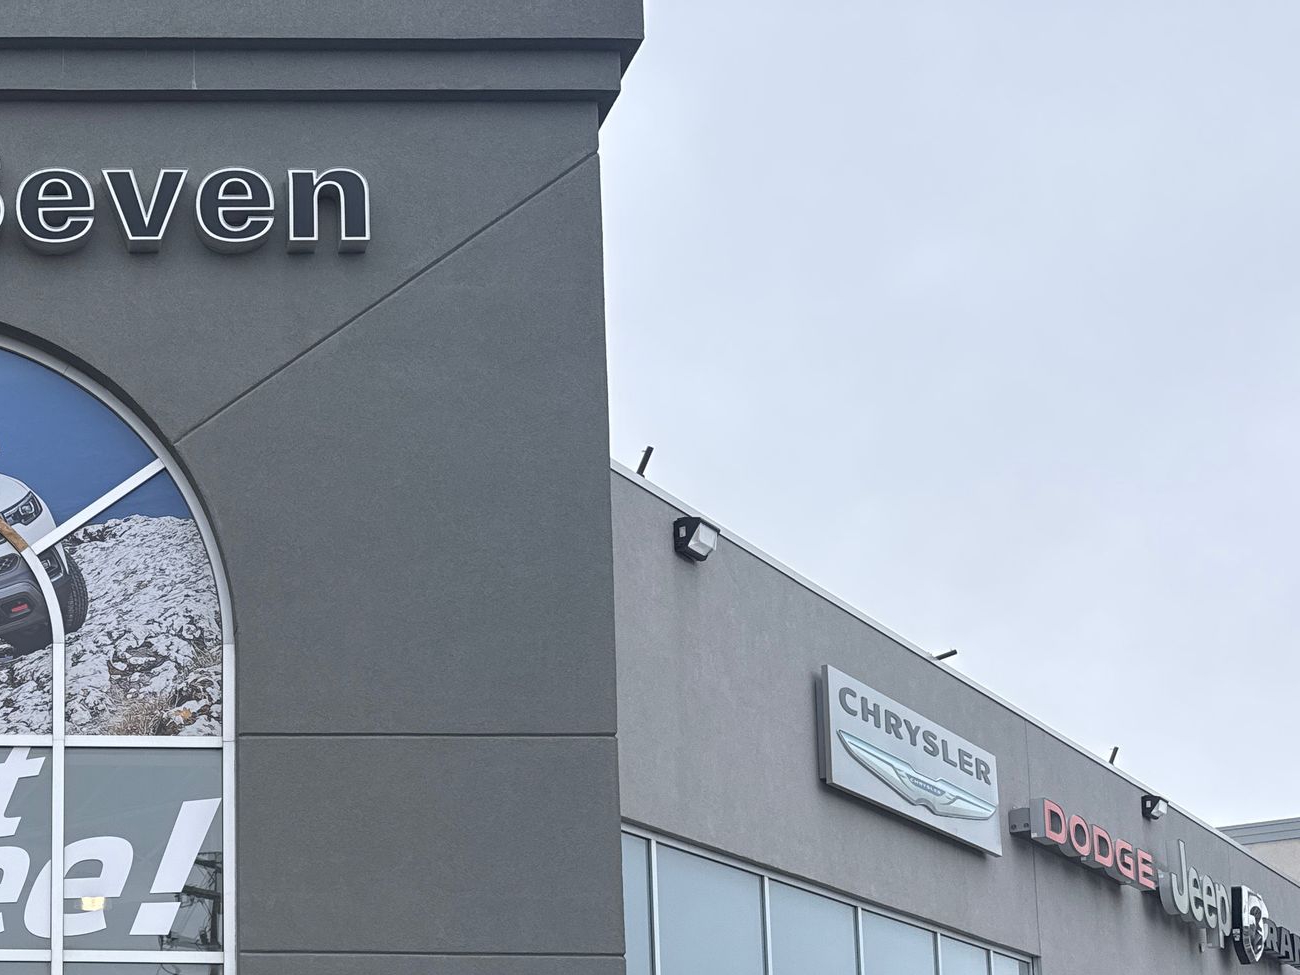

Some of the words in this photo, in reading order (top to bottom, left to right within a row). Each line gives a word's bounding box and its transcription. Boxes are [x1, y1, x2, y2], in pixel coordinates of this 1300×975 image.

[839, 686, 992, 786] CHRYSLER
[1044, 798, 1156, 890] DODGE
[1171, 839, 1232, 949] Jeep
